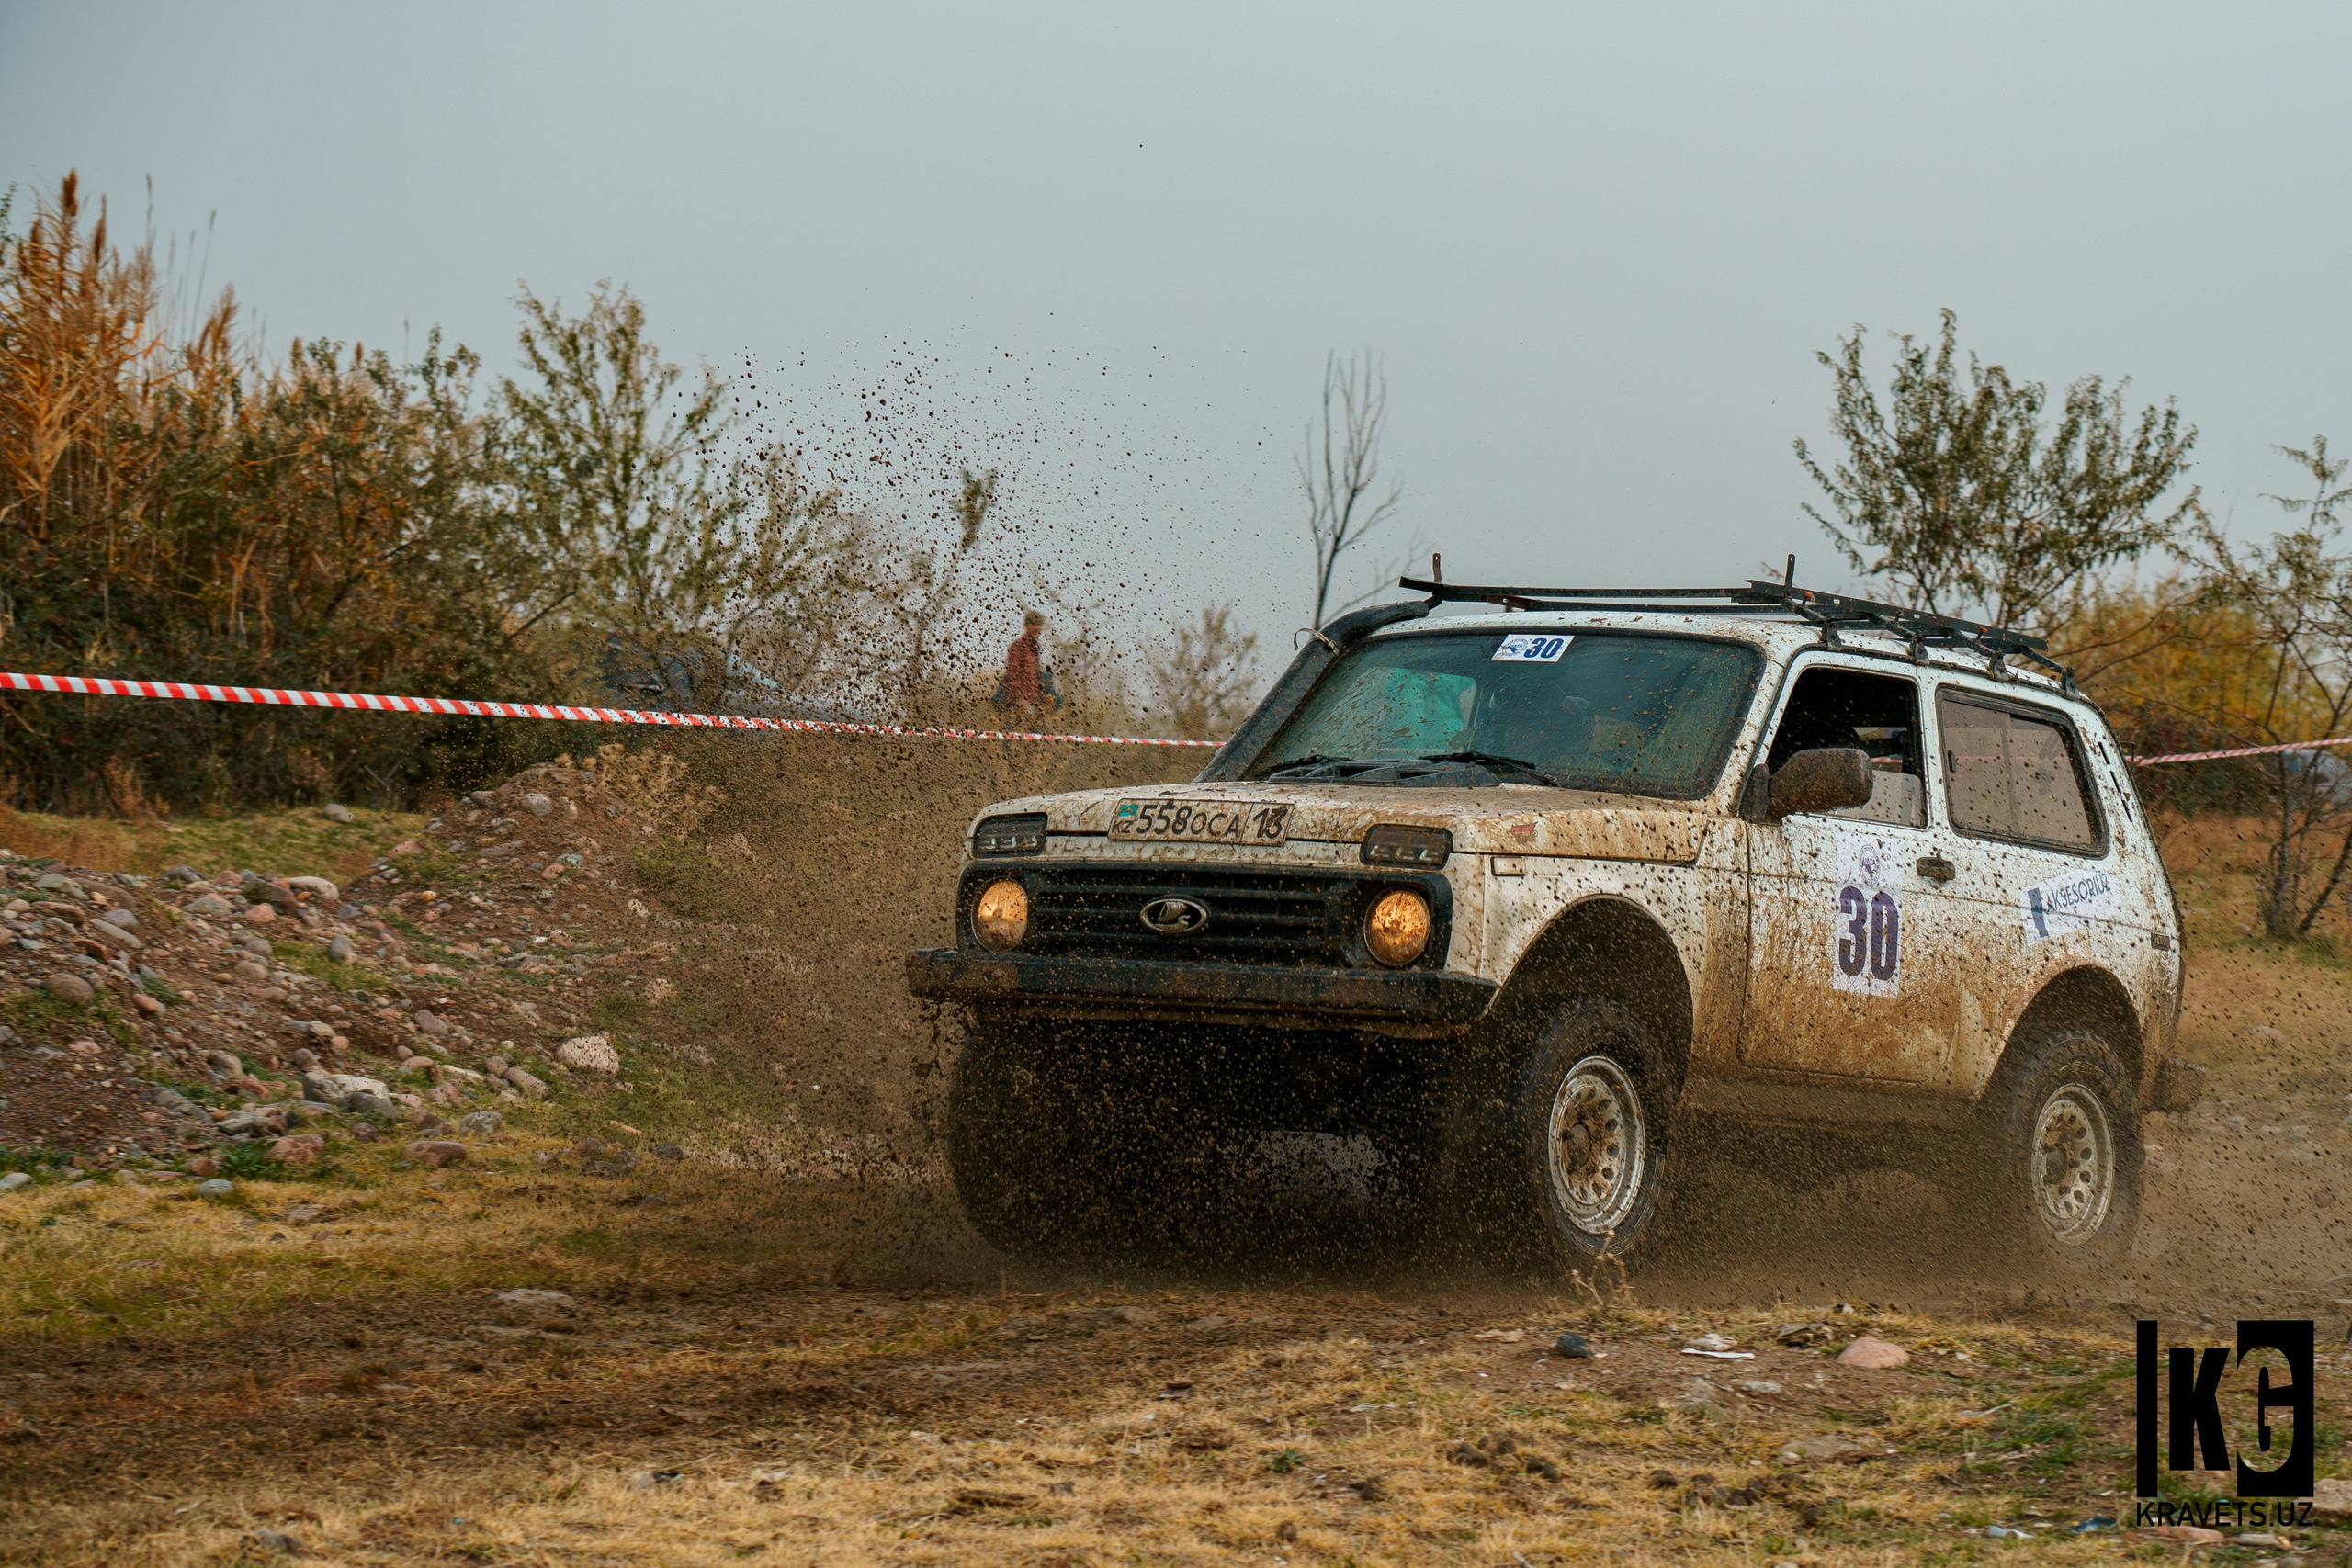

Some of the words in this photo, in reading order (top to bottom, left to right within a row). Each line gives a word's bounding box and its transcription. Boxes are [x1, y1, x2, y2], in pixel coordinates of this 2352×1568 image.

[1523, 637, 1564, 659] 30
[1111, 820, 1134, 834] KZ
[1252, 807, 1287, 839] 13
[1838, 886, 1899, 981] 30
